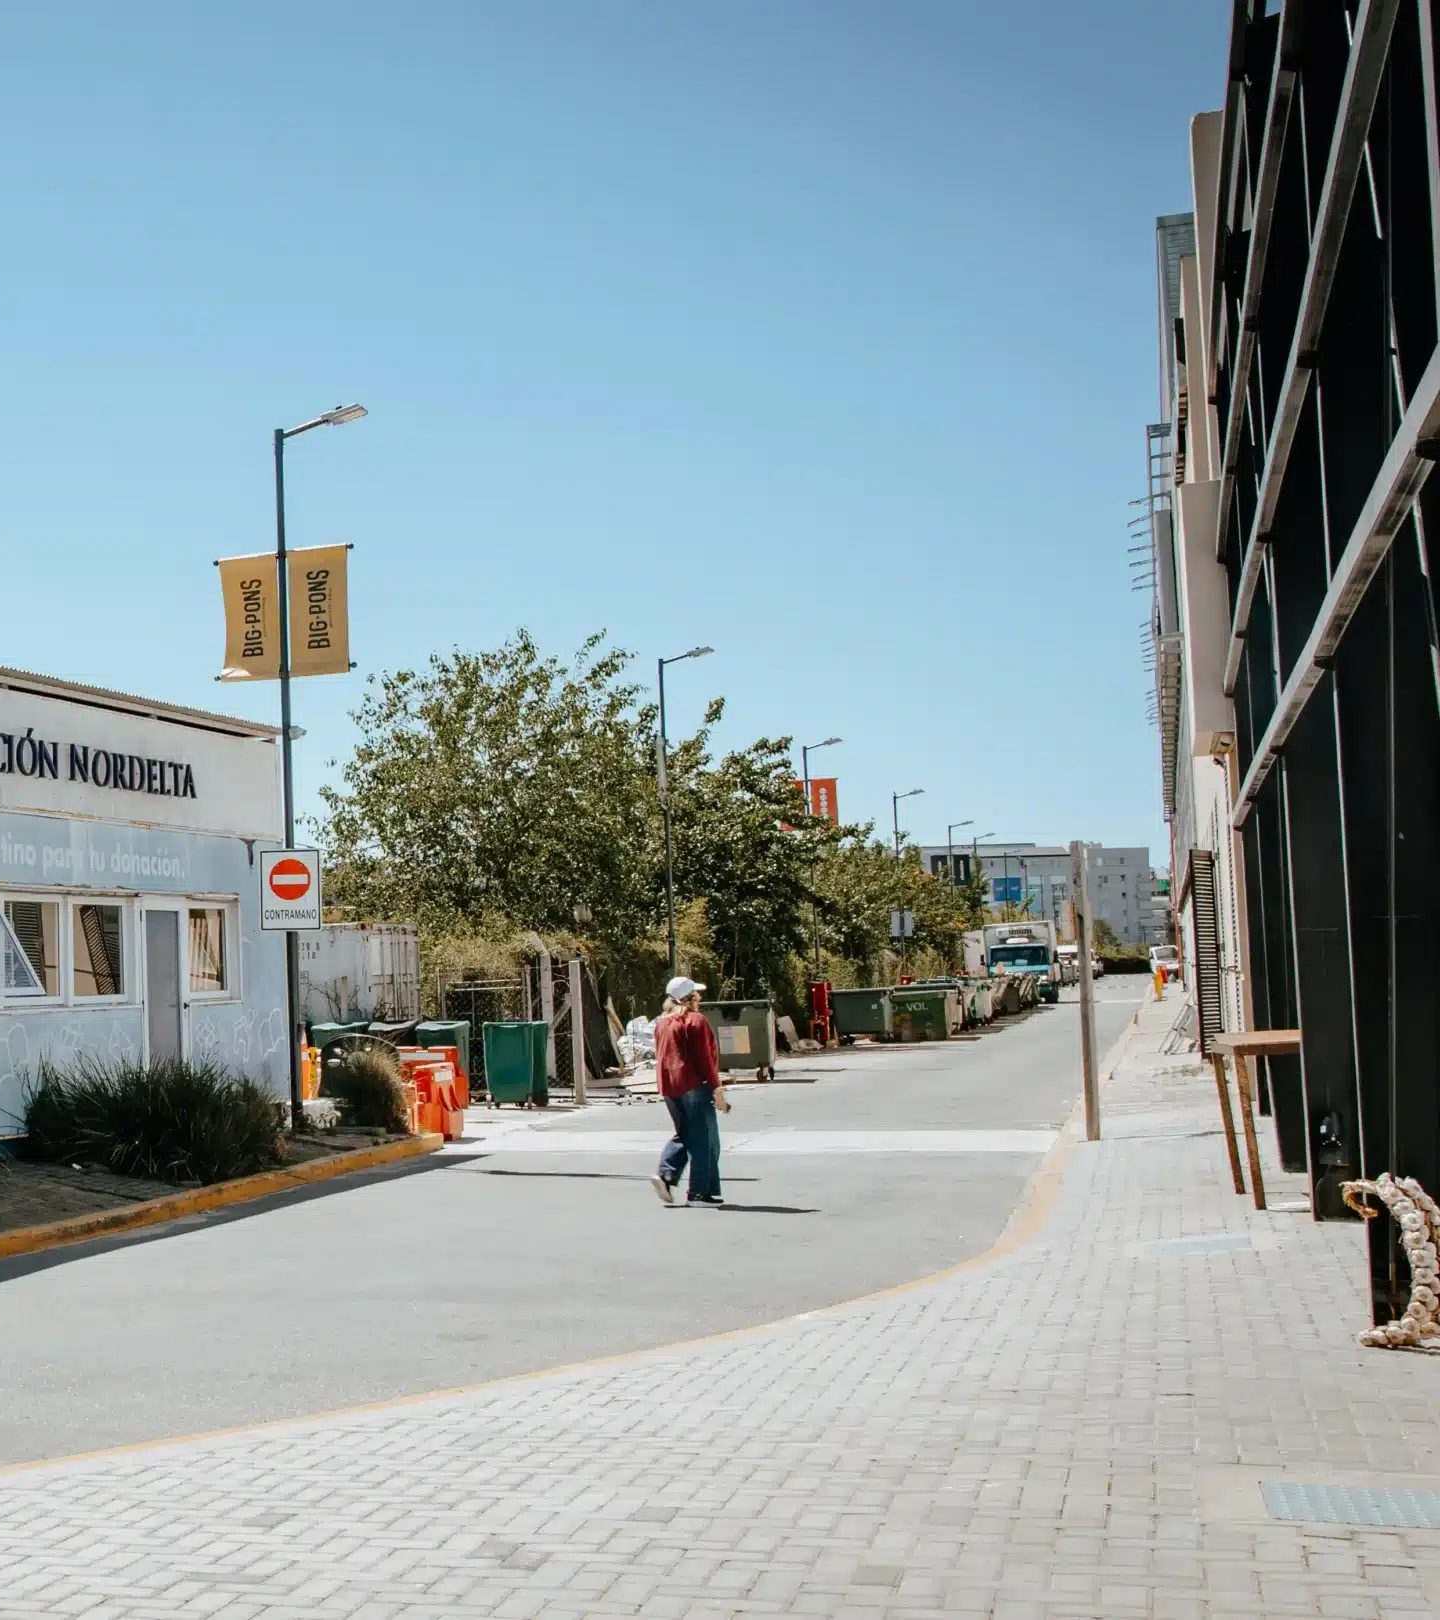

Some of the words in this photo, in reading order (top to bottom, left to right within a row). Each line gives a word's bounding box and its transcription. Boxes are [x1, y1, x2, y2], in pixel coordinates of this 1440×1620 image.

[68, 743, 198, 800] NORDELTA
[89, 843, 105, 872] tu
[264, 909, 317, 920] CONTRAMANO
